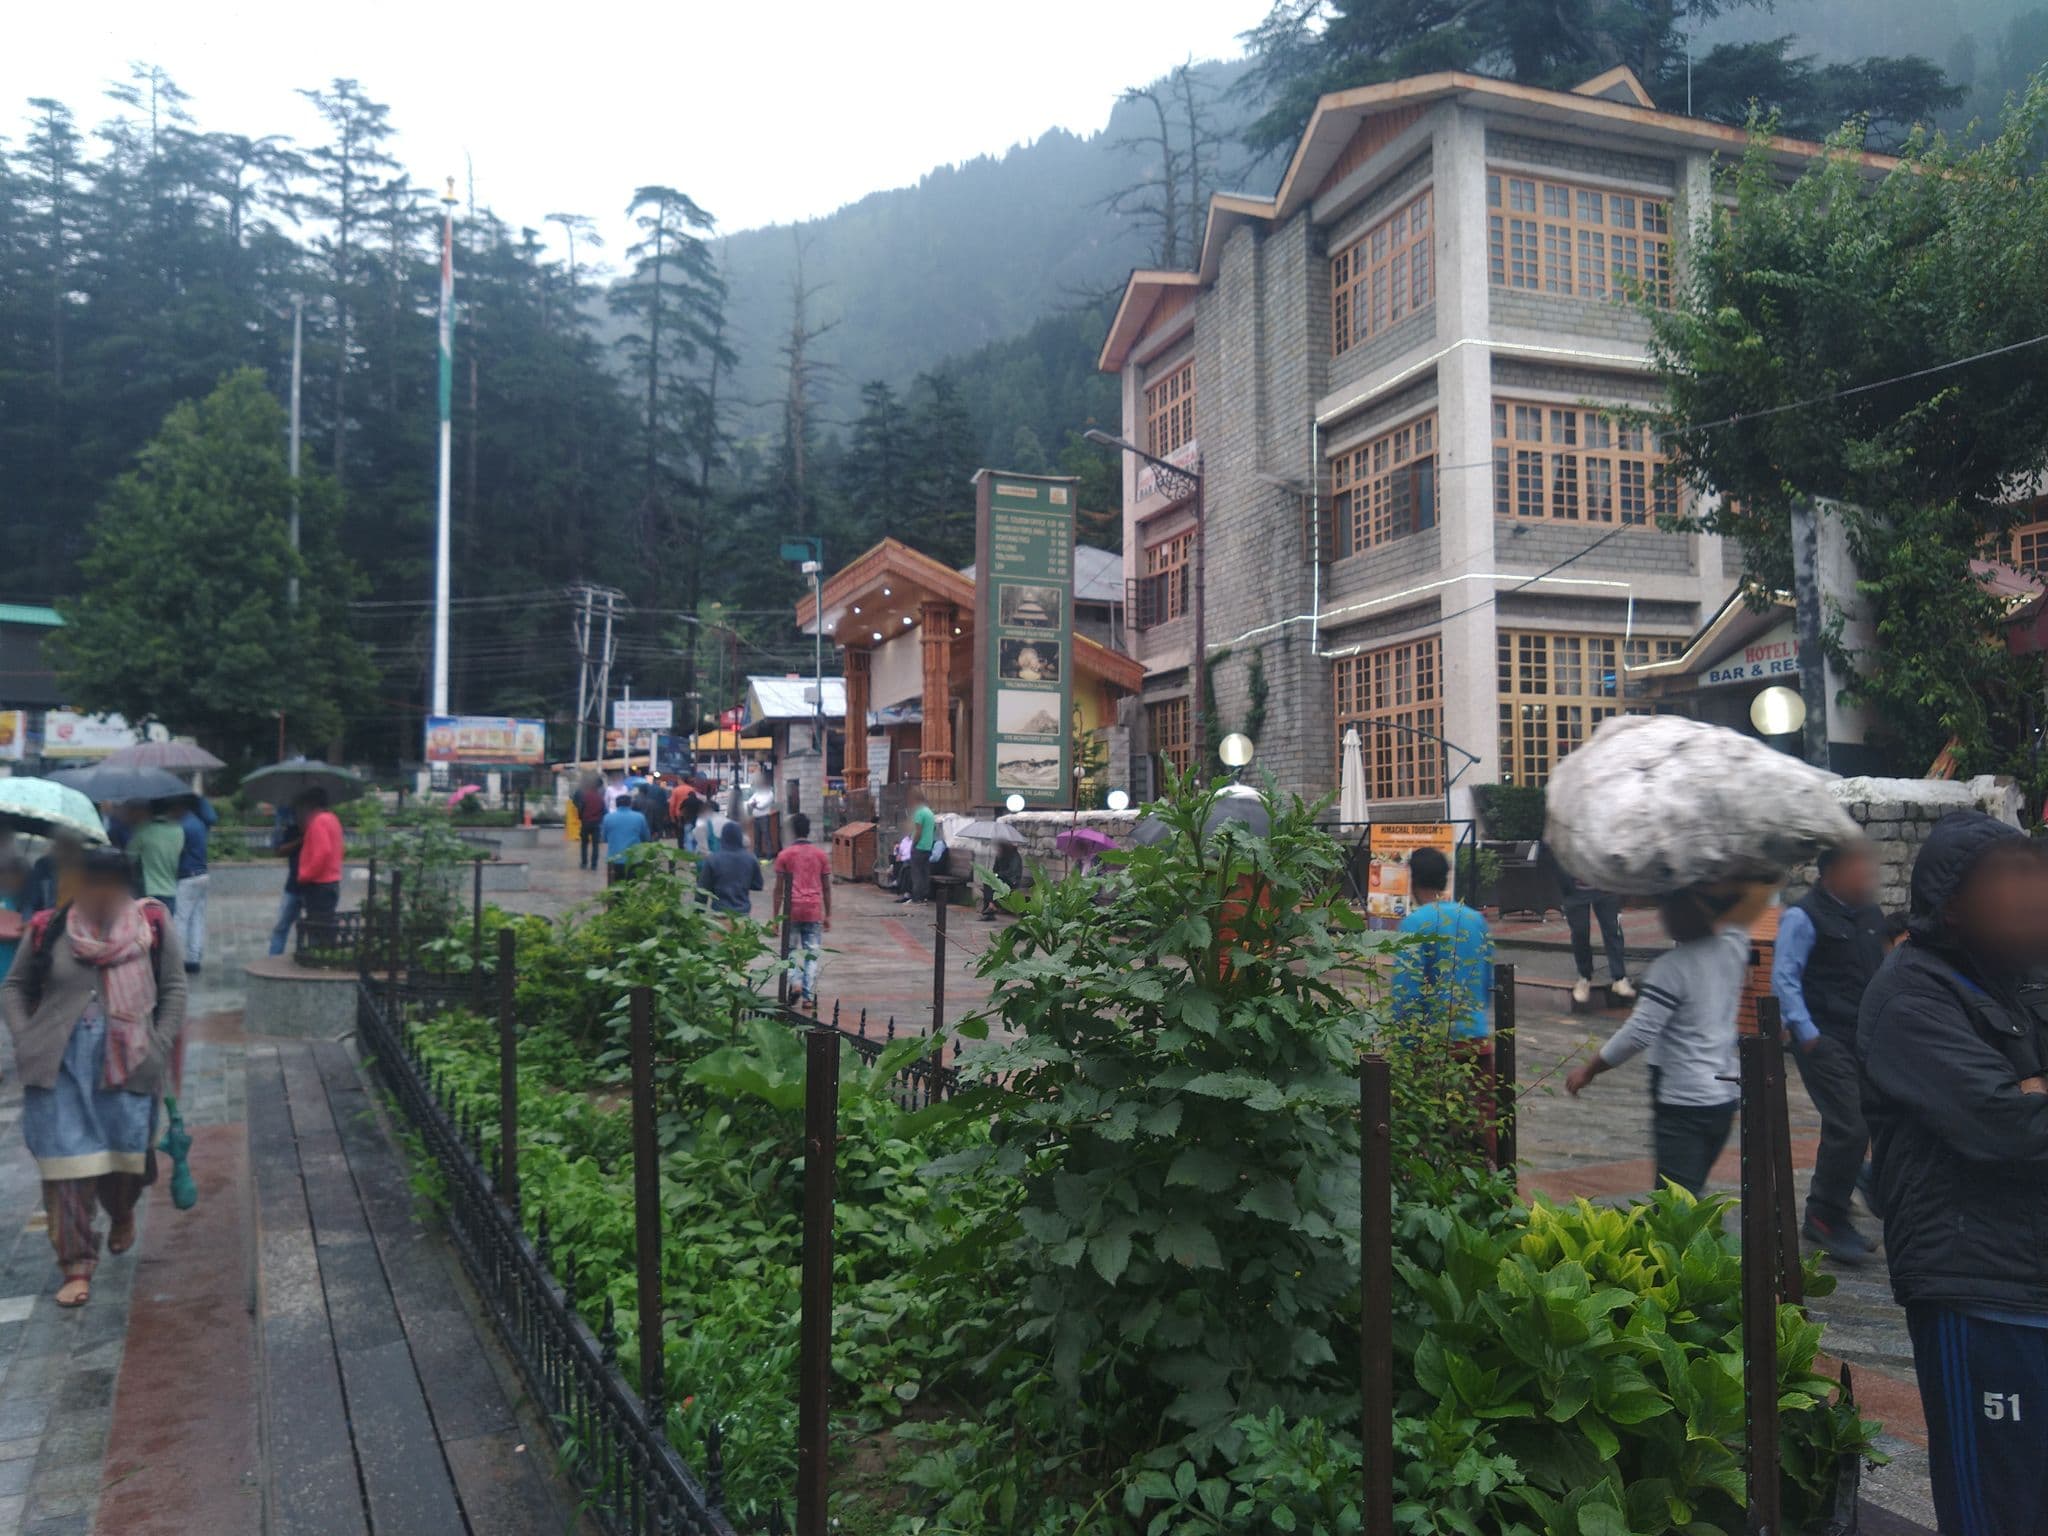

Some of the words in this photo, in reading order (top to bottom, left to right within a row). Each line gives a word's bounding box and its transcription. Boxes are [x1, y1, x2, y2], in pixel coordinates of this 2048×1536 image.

[1745, 642, 1789, 663] HOTEL
[1710, 668, 1744, 682] BAR
[1751, 664, 1763, 676] &
[1984, 1392, 2021, 1421] 51
